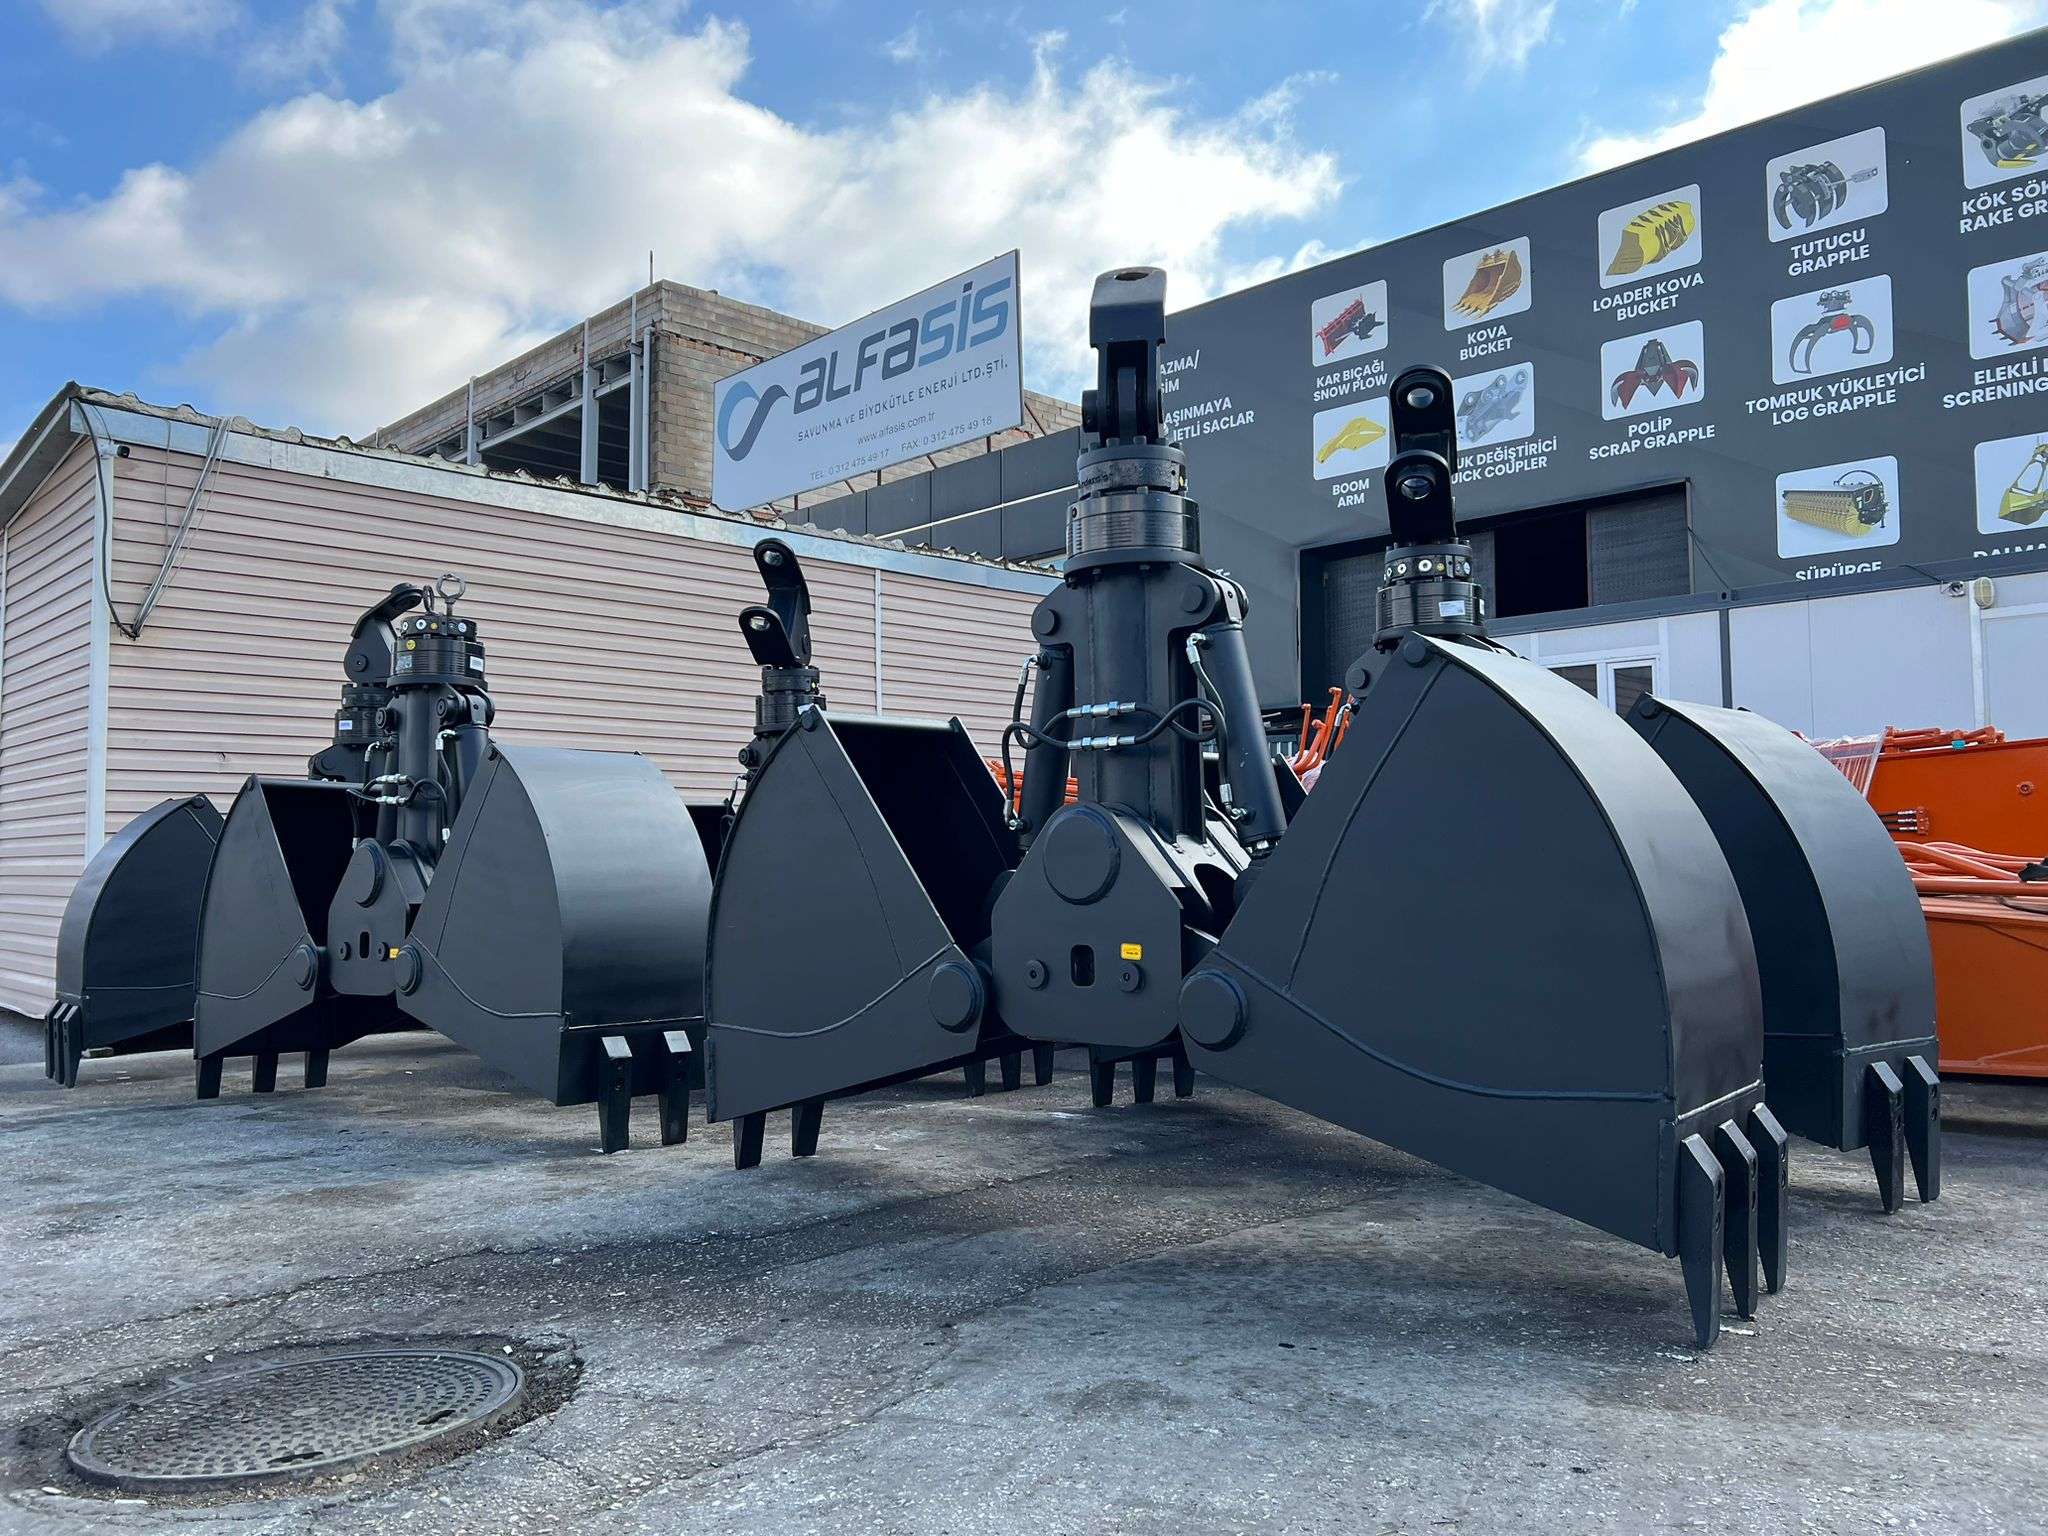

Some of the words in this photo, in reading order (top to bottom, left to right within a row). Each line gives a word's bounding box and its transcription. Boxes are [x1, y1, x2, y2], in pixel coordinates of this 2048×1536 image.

[1962, 190, 2007, 215] KÖK
[1960, 207, 2014, 234] RAKE
[1790, 228, 1866, 260] TUTUCU
[1788, 244, 1870, 277] GRAPPLE
[1593, 285, 1653, 313] LOADER
[1656, 272, 1705, 297] KOVA
[1616, 294, 1679, 322] BUCKET
[1460, 337, 1513, 361] BUCKET
[1467, 325, 1507, 345] KOVA
[1316, 373, 1340, 389] KAR
[1343, 359, 1384, 381] BIÇAĞI
[1974, 356, 2038, 386] ELEKLİ
[1313, 383, 1350, 402] SNOW
[1353, 373, 1388, 392] PLOW
[1745, 386, 1824, 414] TOMRUK
[1826, 362, 1926, 397] YÜKLEYİCİ
[1943, 377, 2048, 409] SCRENING
[797, 418, 842, 442] SAVUNMA
[845, 414, 856, 425] VE
[858, 391, 914, 420] BİYOKÜTLE
[918, 371, 957, 399] ENERJİ
[1164, 397, 1232, 427] AŞINMAYA
[1772, 405, 1809, 426] LOG
[1812, 389, 1897, 417] GRAPPLE
[1203, 410, 1255, 435] SACLAR
[1628, 415, 1673, 438] POLİP
[1476, 435, 1557, 466] DEĞİŞTİRİCİ
[1589, 439, 1641, 460] SCRAP
[1643, 424, 1716, 450] GRAPPLE
[1484, 455, 1548, 478] COUPLER
[1332, 478, 1370, 497] BOOM
[1337, 493, 1365, 508] ARM
